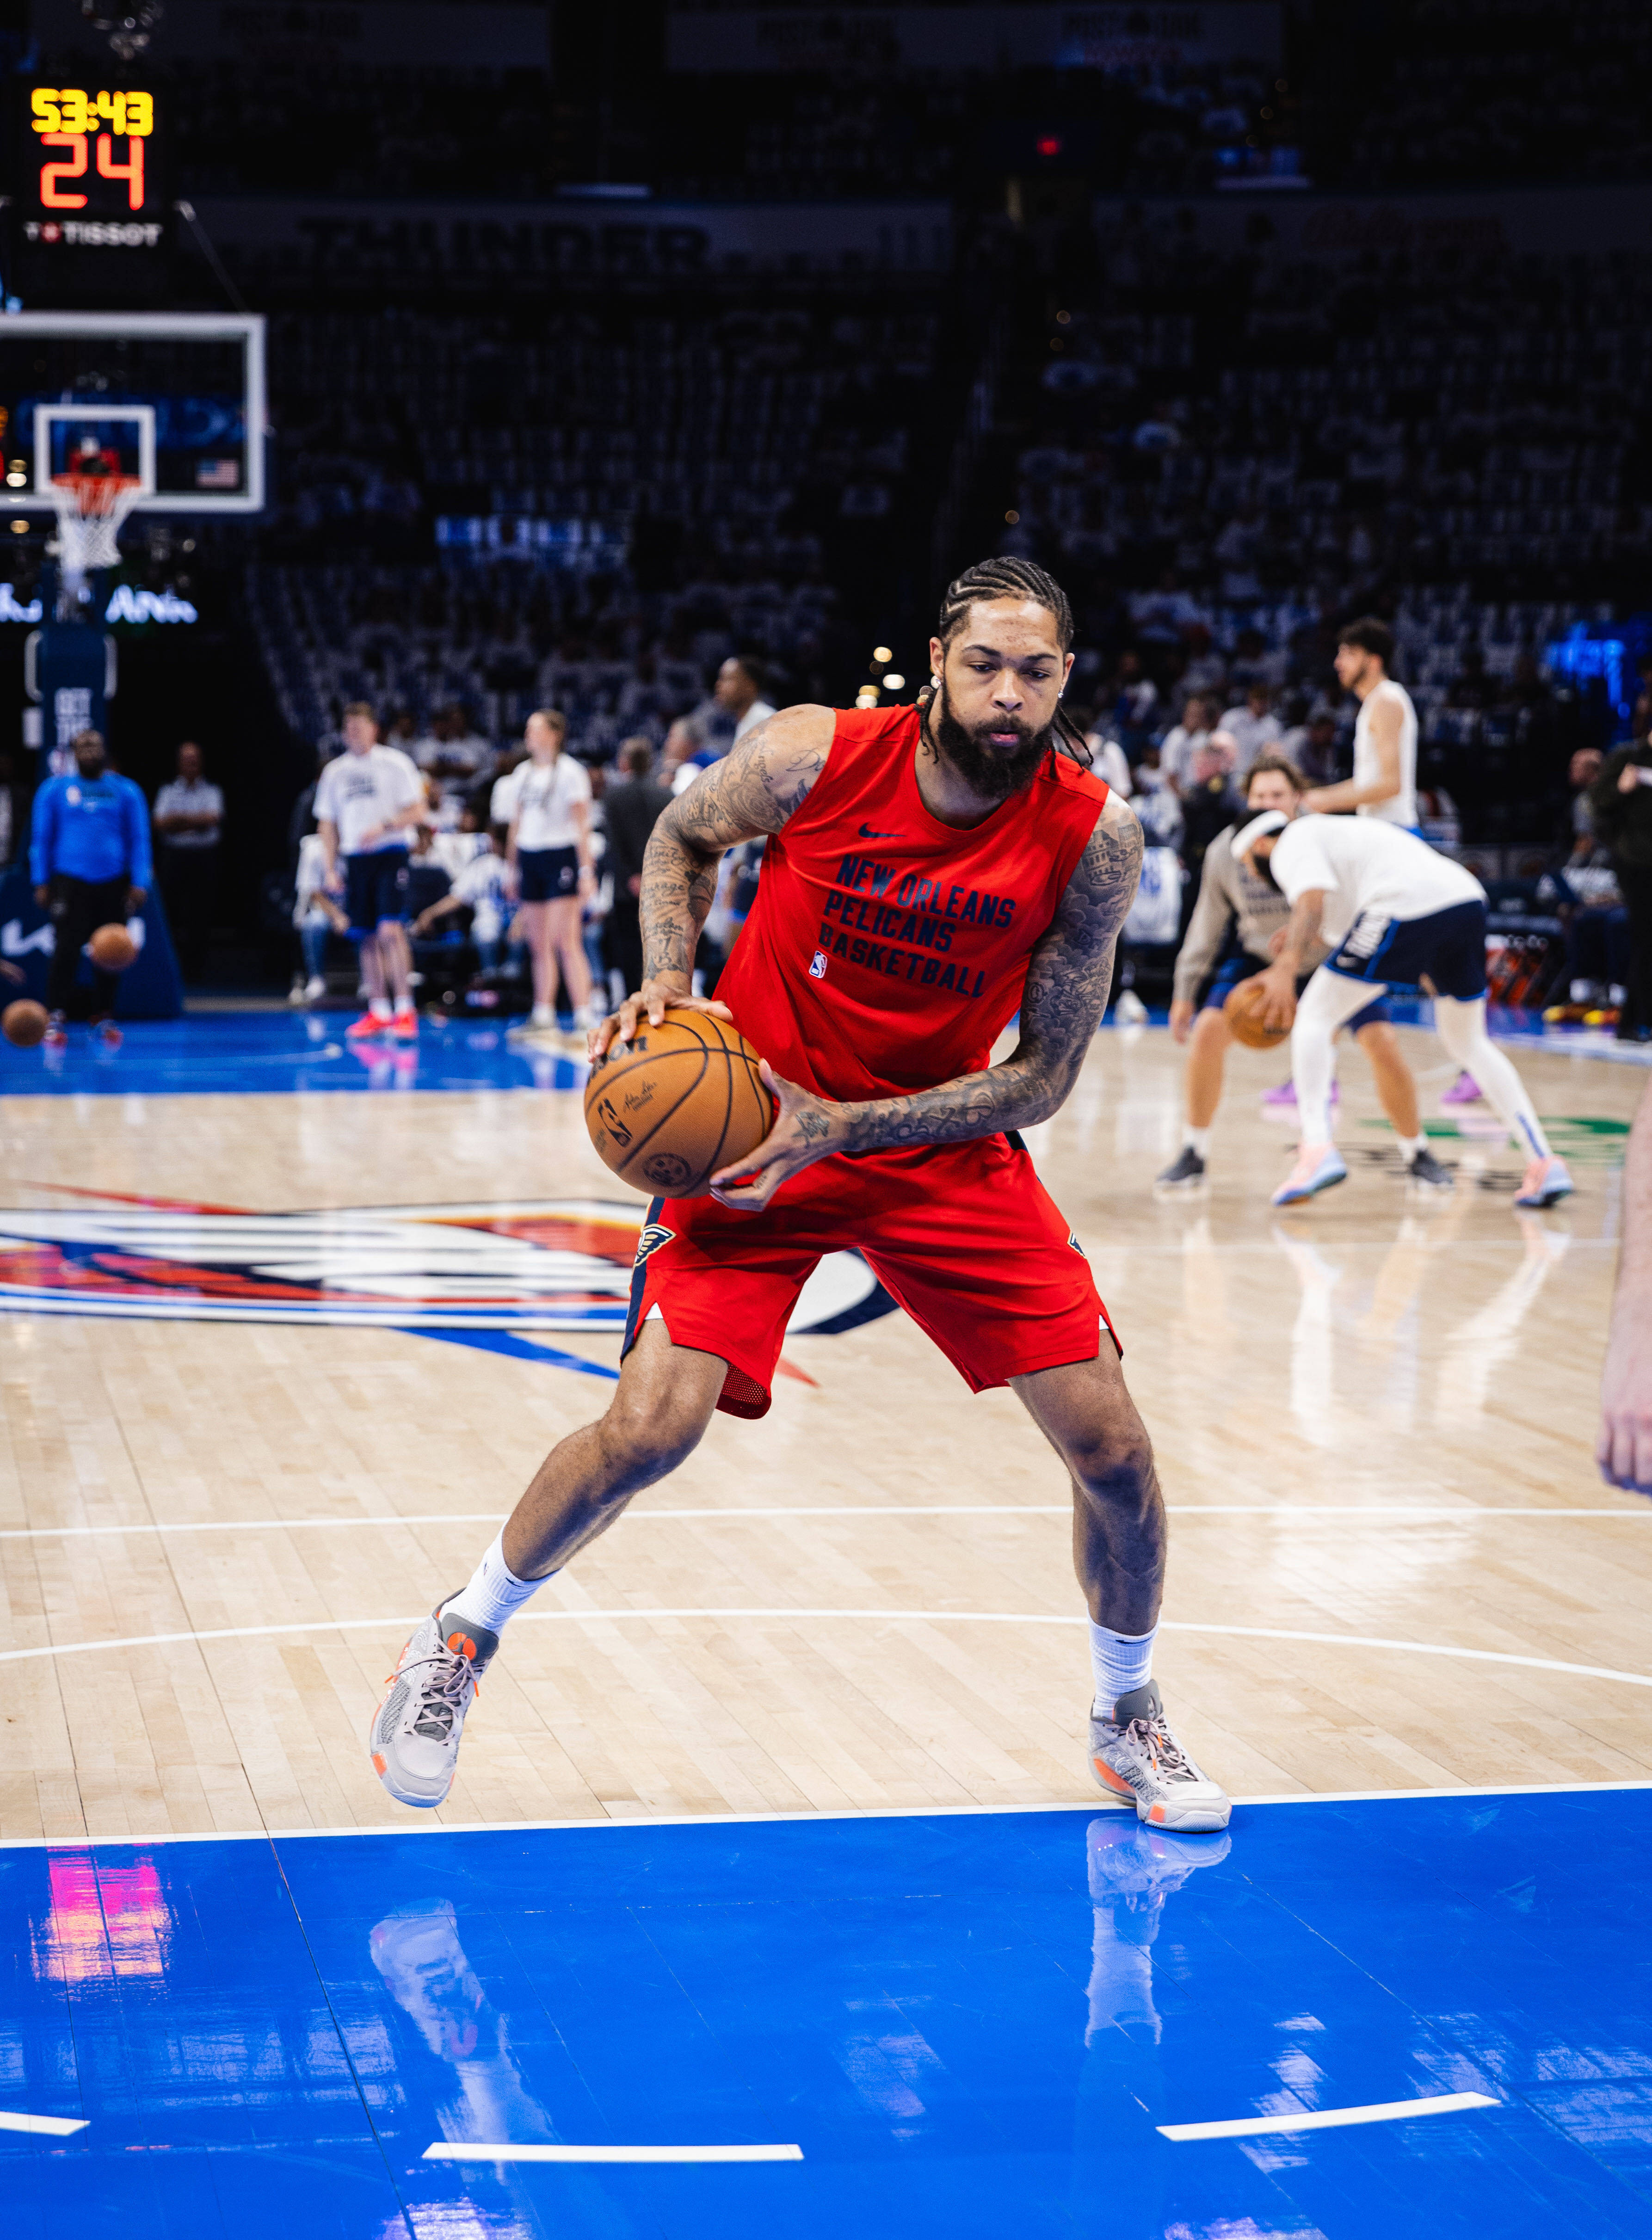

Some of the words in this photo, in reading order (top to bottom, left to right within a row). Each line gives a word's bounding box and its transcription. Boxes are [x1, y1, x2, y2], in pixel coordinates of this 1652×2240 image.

[31, 88, 153, 136] 53:43
[41, 132, 144, 210] 24
[823, 890, 955, 952] PELICANS
[836, 855, 896, 898] NEW
[896, 874, 1016, 928] ORLEANS
[818, 922, 985, 998] BASKETBALL
